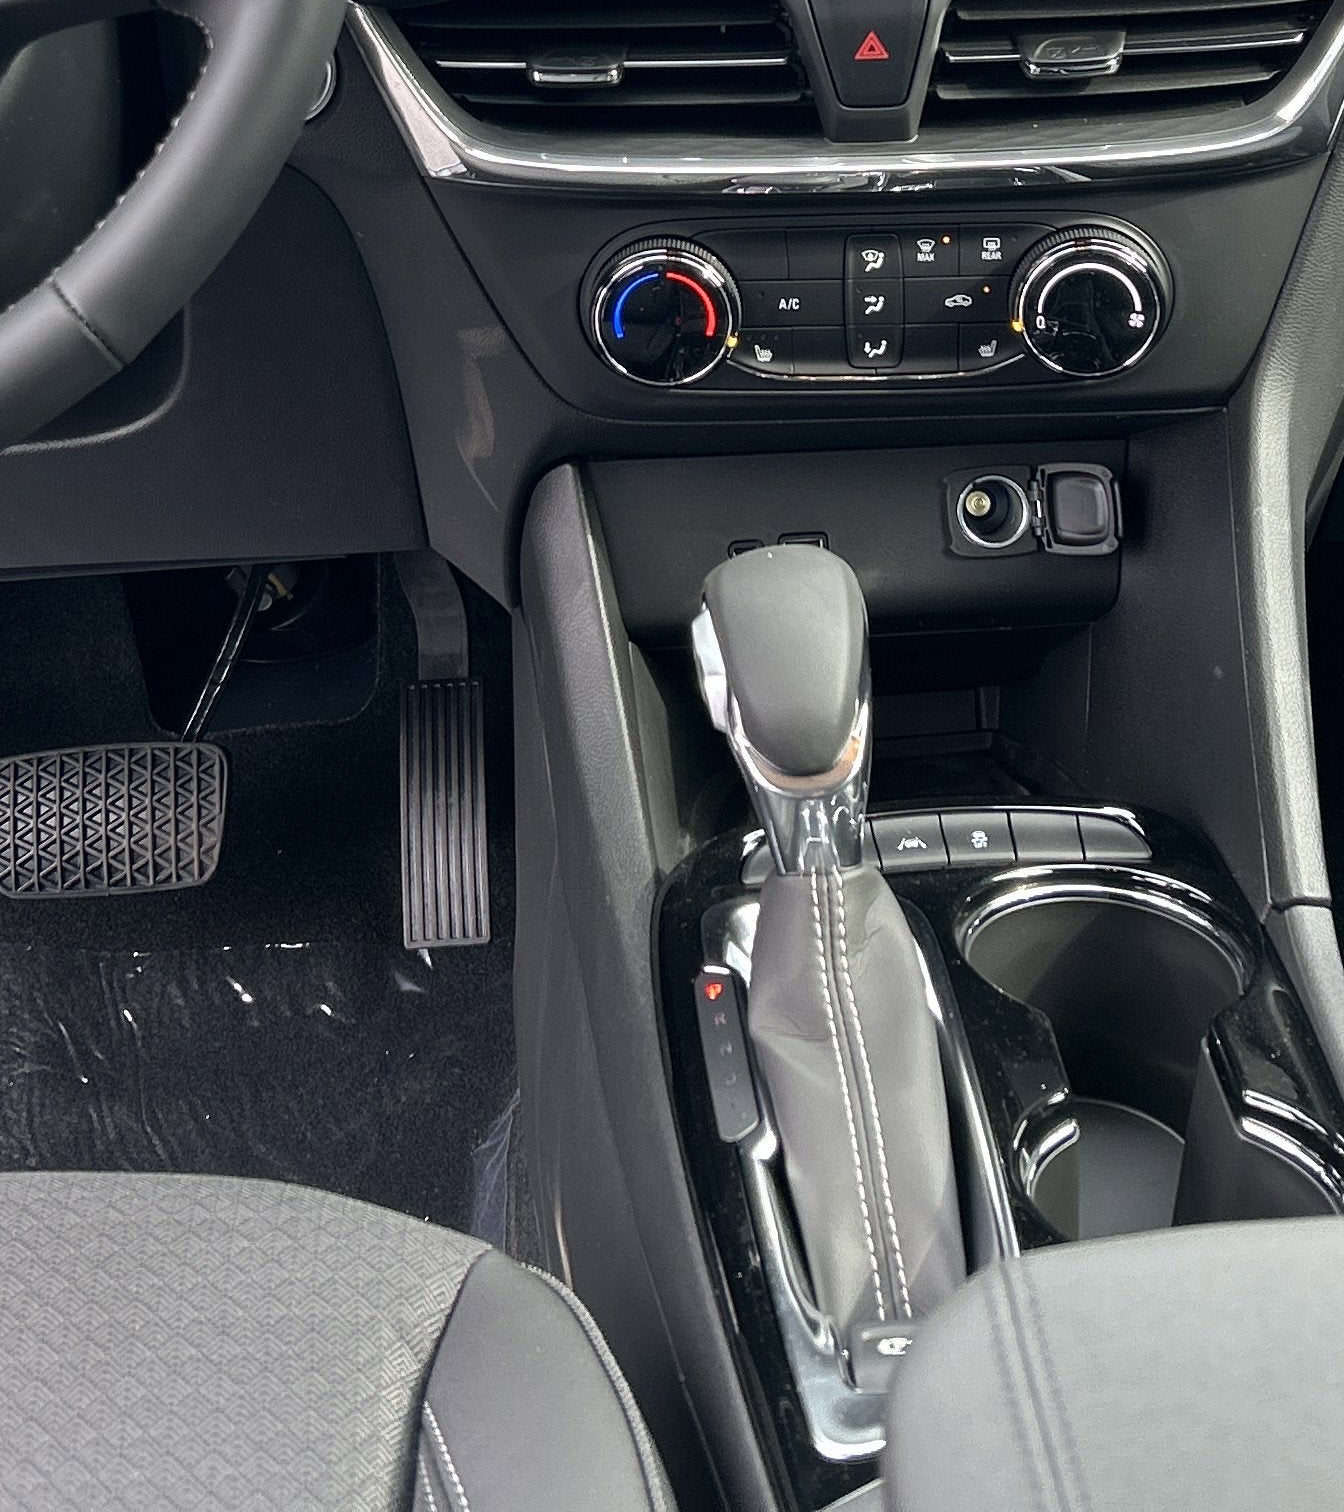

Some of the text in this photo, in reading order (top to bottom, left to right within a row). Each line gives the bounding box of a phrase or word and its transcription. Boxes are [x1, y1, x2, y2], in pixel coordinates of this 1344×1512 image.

[917, 252, 935, 263] MAX
[981, 250, 1002, 261] REAR
[778, 298, 800, 311] A/C
